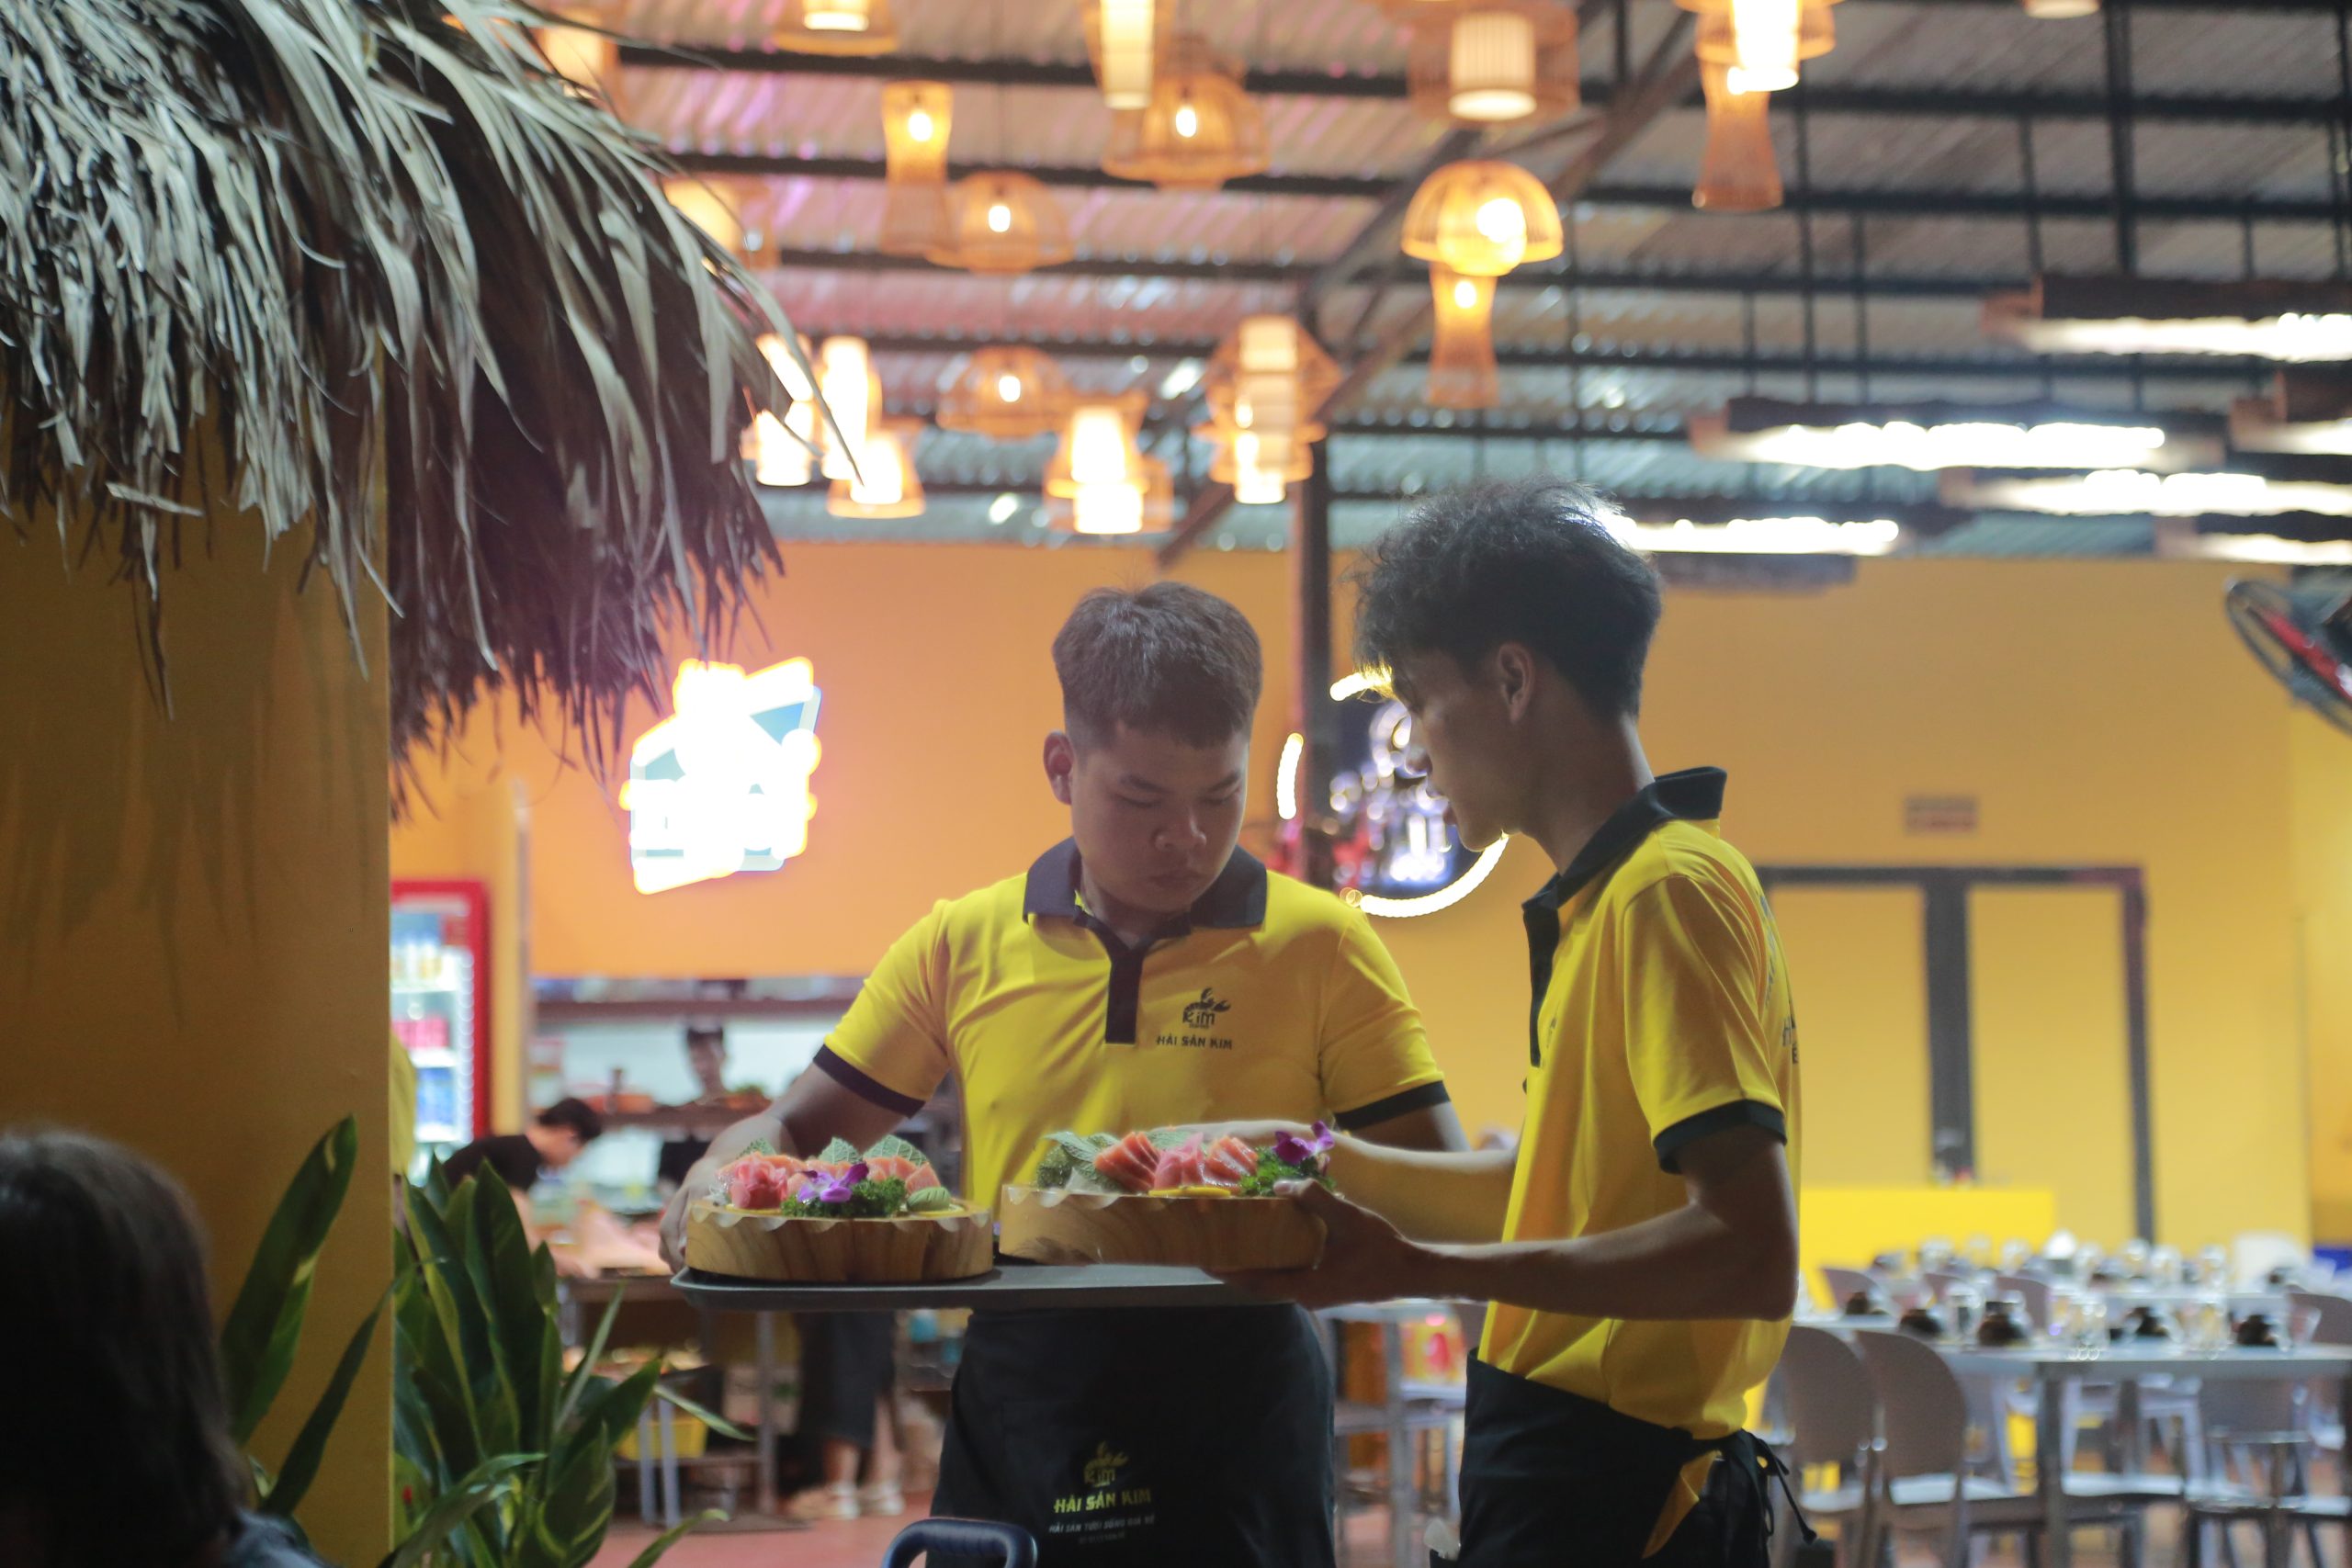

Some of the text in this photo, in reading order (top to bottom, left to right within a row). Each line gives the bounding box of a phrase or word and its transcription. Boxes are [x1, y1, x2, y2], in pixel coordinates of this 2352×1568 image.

[1210, 1038, 1233, 1050] KIM
[1054, 1488, 1151, 1513] HẢI SẢN KIM
